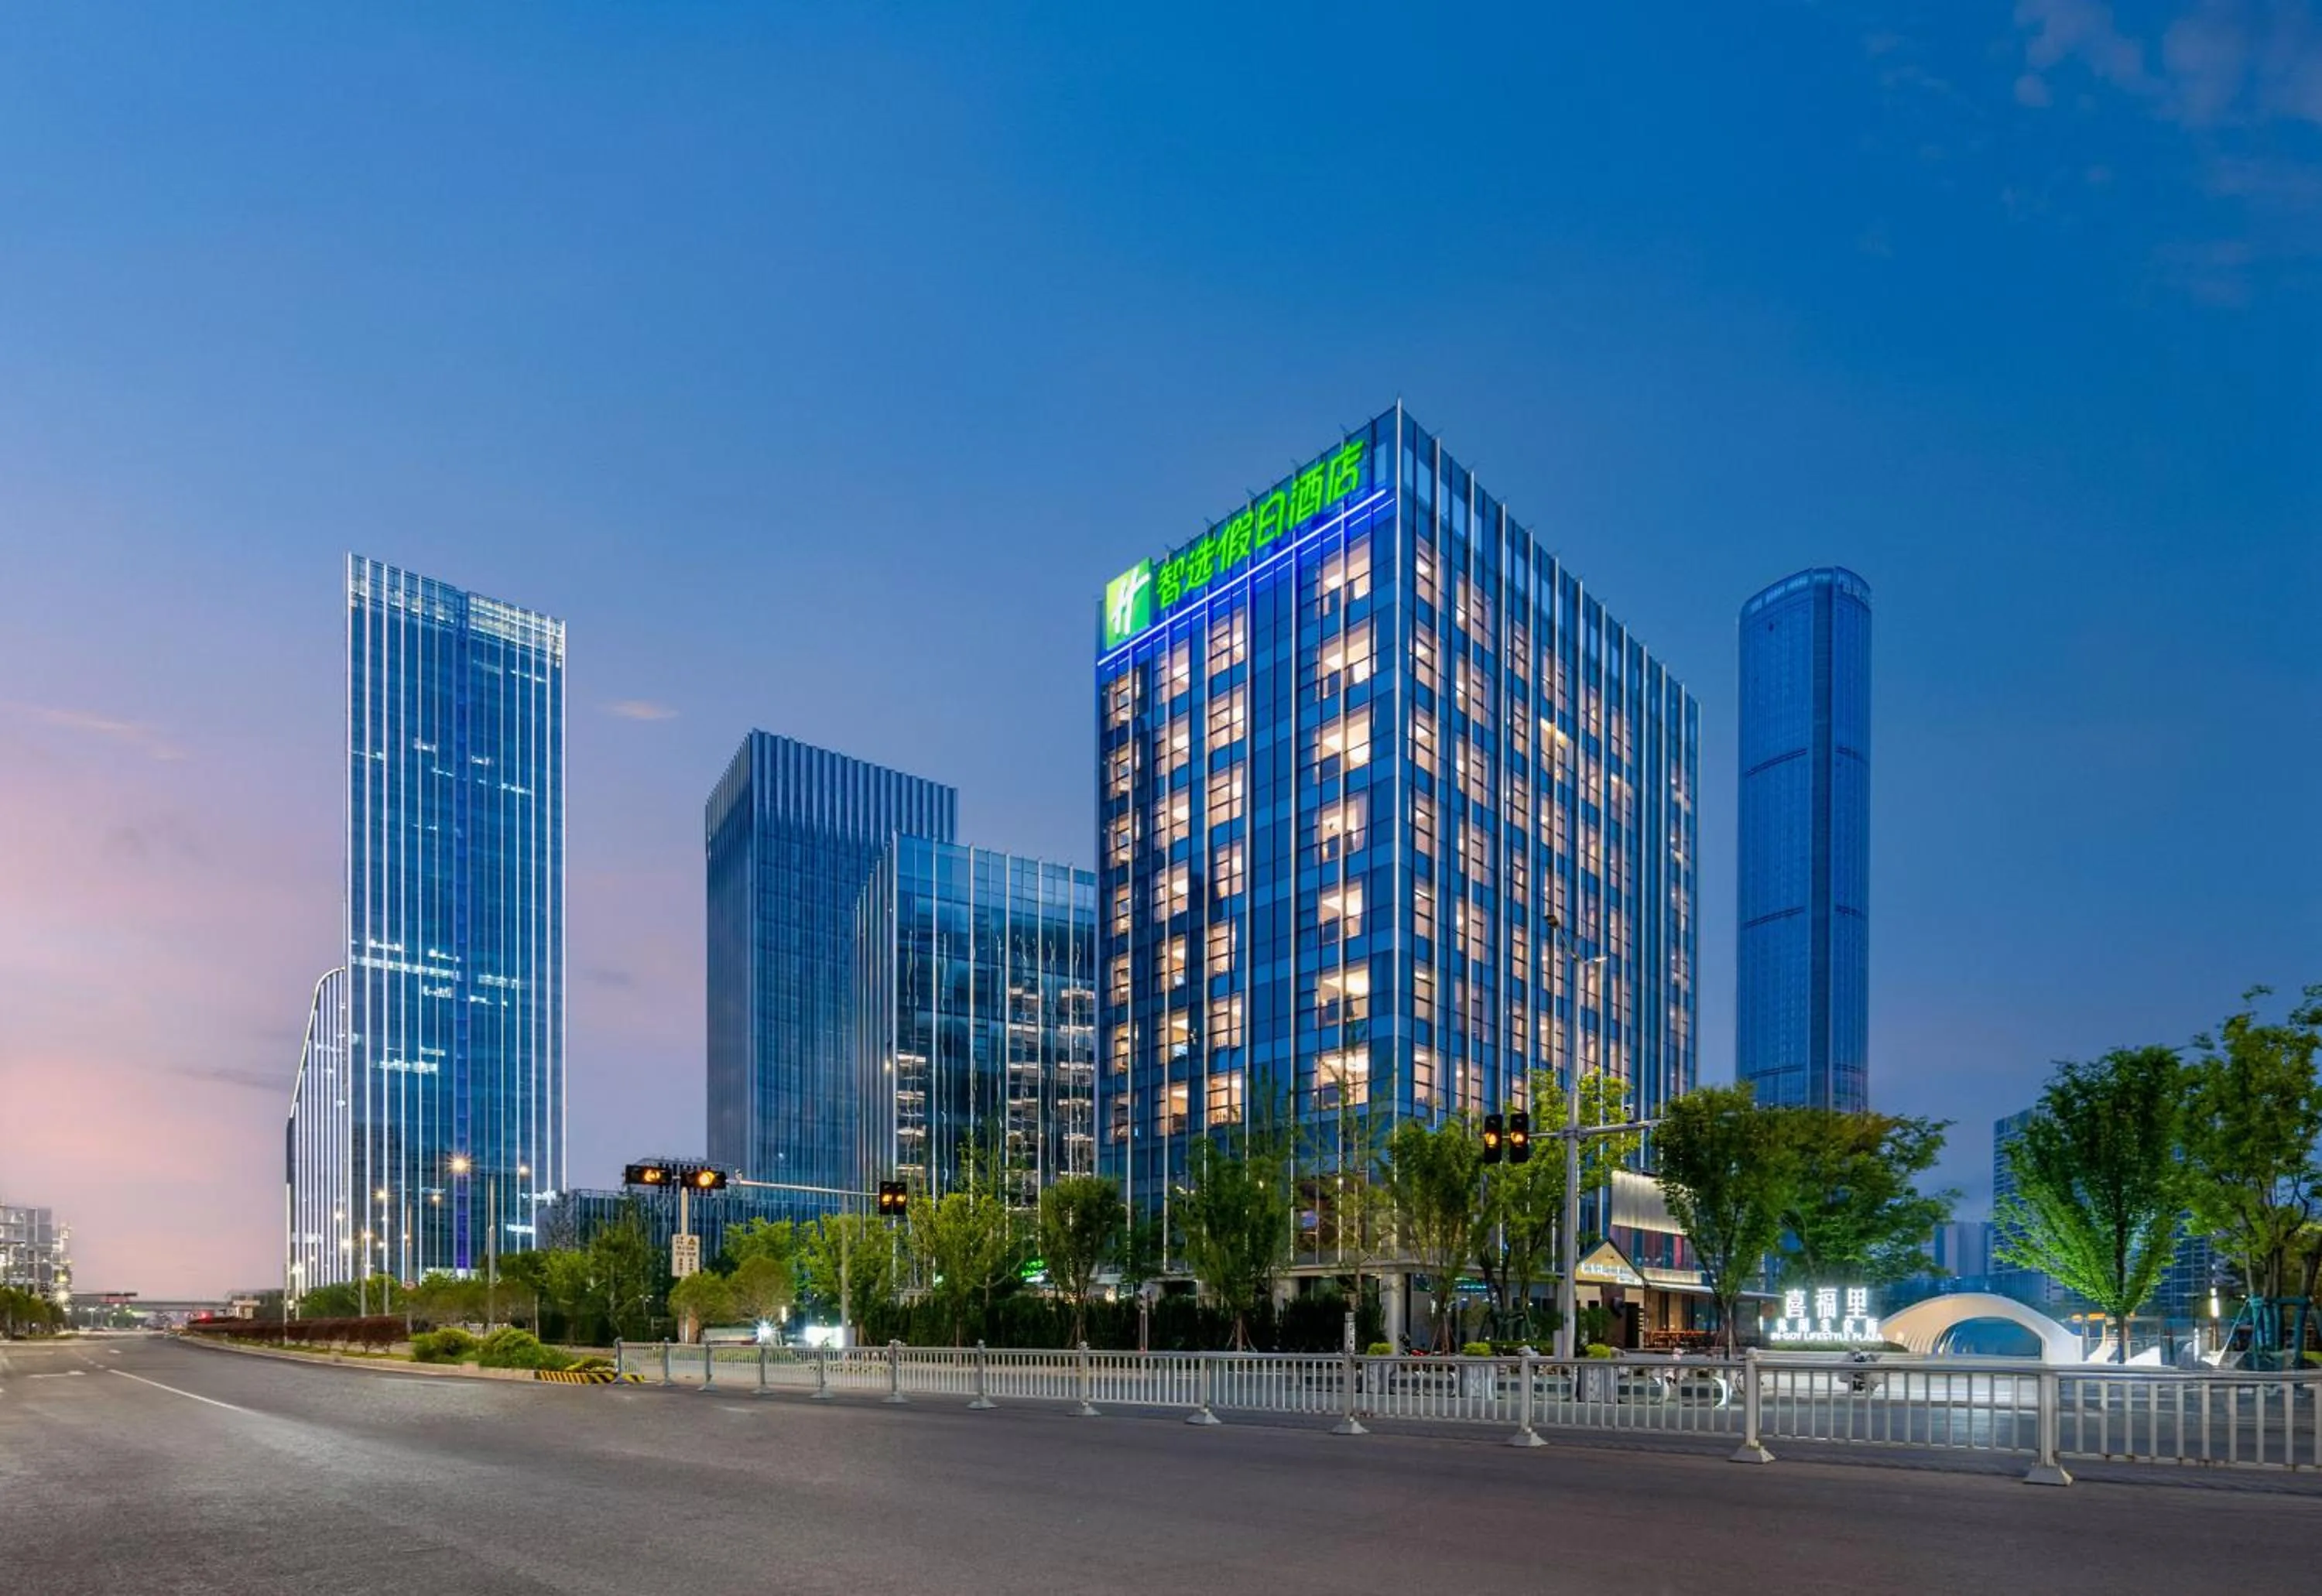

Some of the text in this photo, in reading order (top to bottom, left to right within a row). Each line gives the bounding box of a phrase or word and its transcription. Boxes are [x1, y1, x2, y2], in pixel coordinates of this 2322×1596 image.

[1156, 440, 1365, 610] 智选假日酒店
